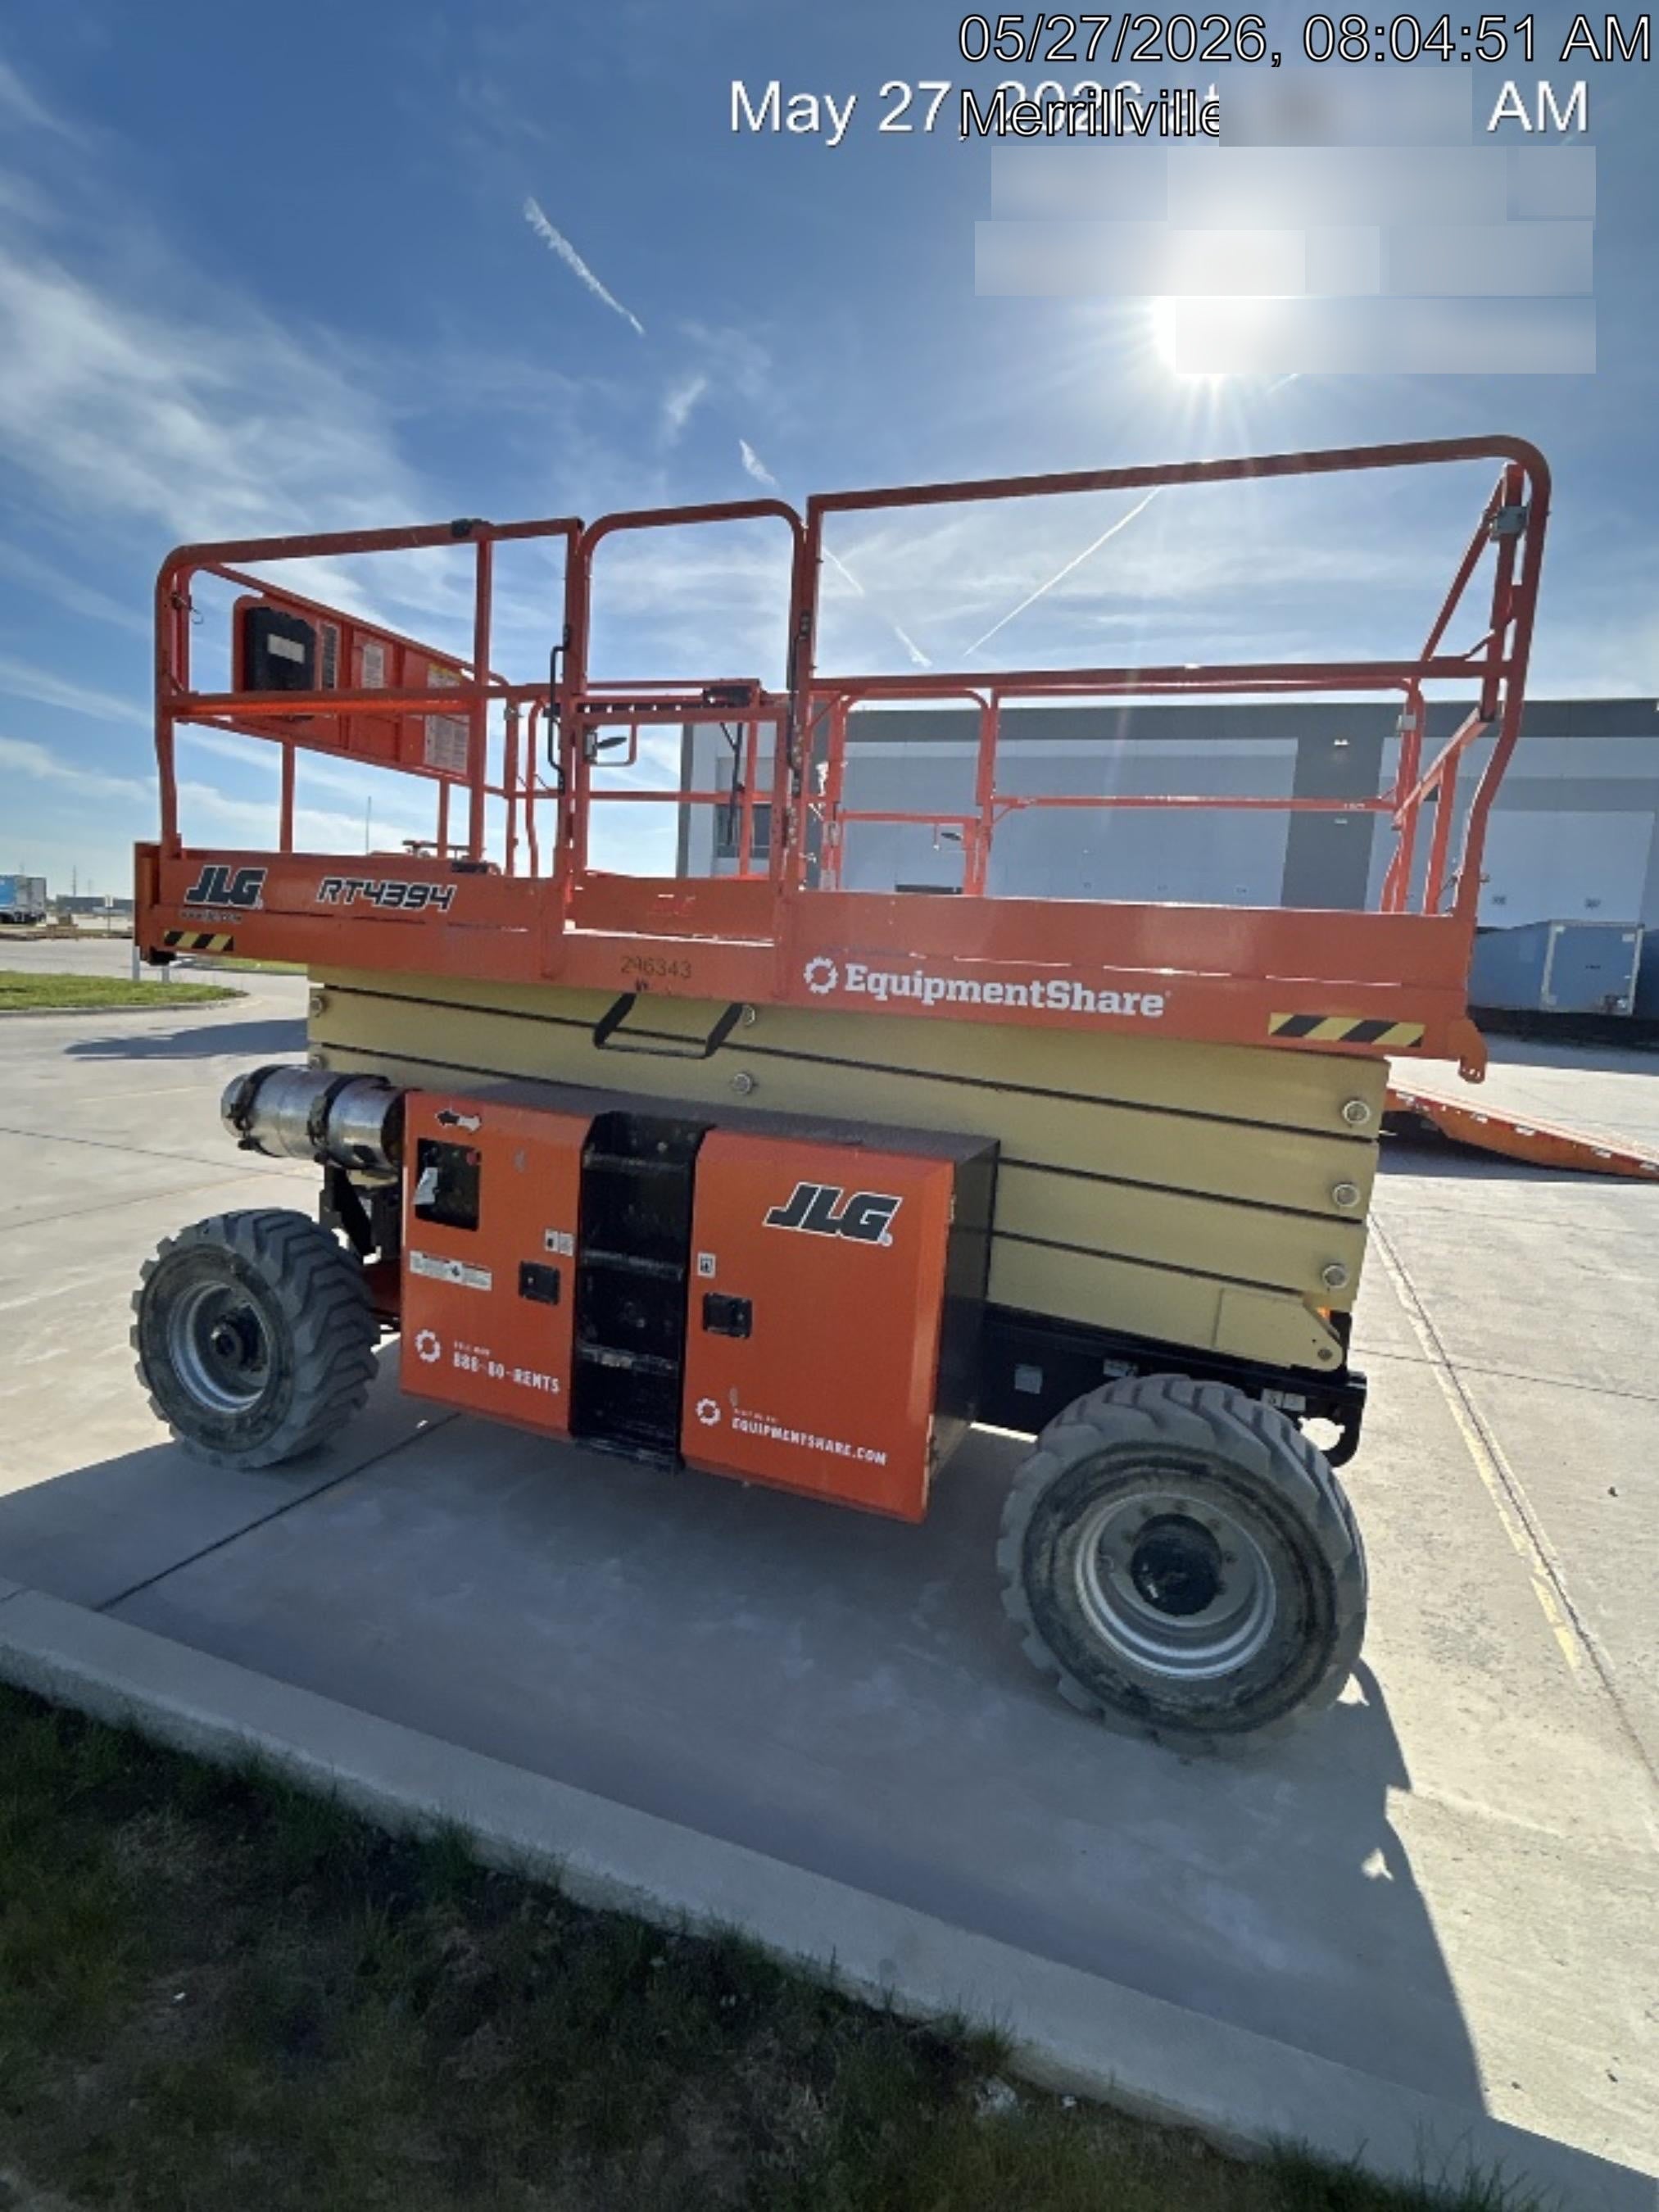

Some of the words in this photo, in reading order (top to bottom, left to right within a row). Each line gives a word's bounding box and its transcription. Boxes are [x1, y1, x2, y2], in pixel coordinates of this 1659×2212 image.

[184, 864, 268, 909] JLG
[317, 877, 457, 912] RT4394
[844, 963, 1164, 1018] EquipmentShare
[763, 1181, 903, 1245] JLG
[732, 1417, 886, 1466] EQUIPMENTSHARE.COM
